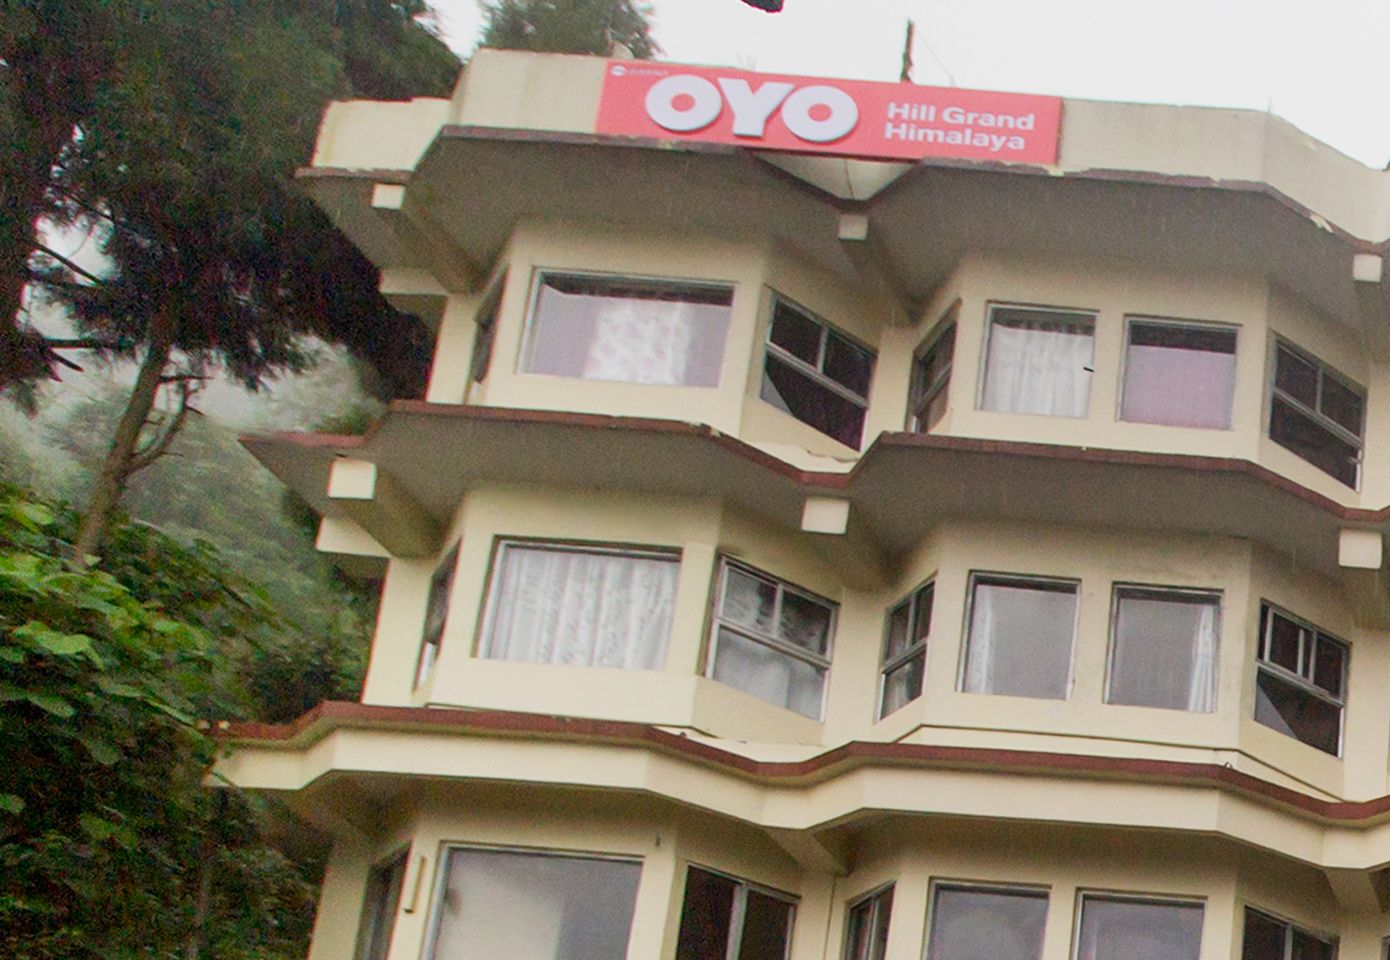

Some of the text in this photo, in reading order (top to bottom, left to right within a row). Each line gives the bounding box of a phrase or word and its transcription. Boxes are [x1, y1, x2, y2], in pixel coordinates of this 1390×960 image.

[645, 73, 859, 142] OYO
[887, 101, 1035, 131] Hill Grand
[884, 121, 1026, 152] Himalaya
